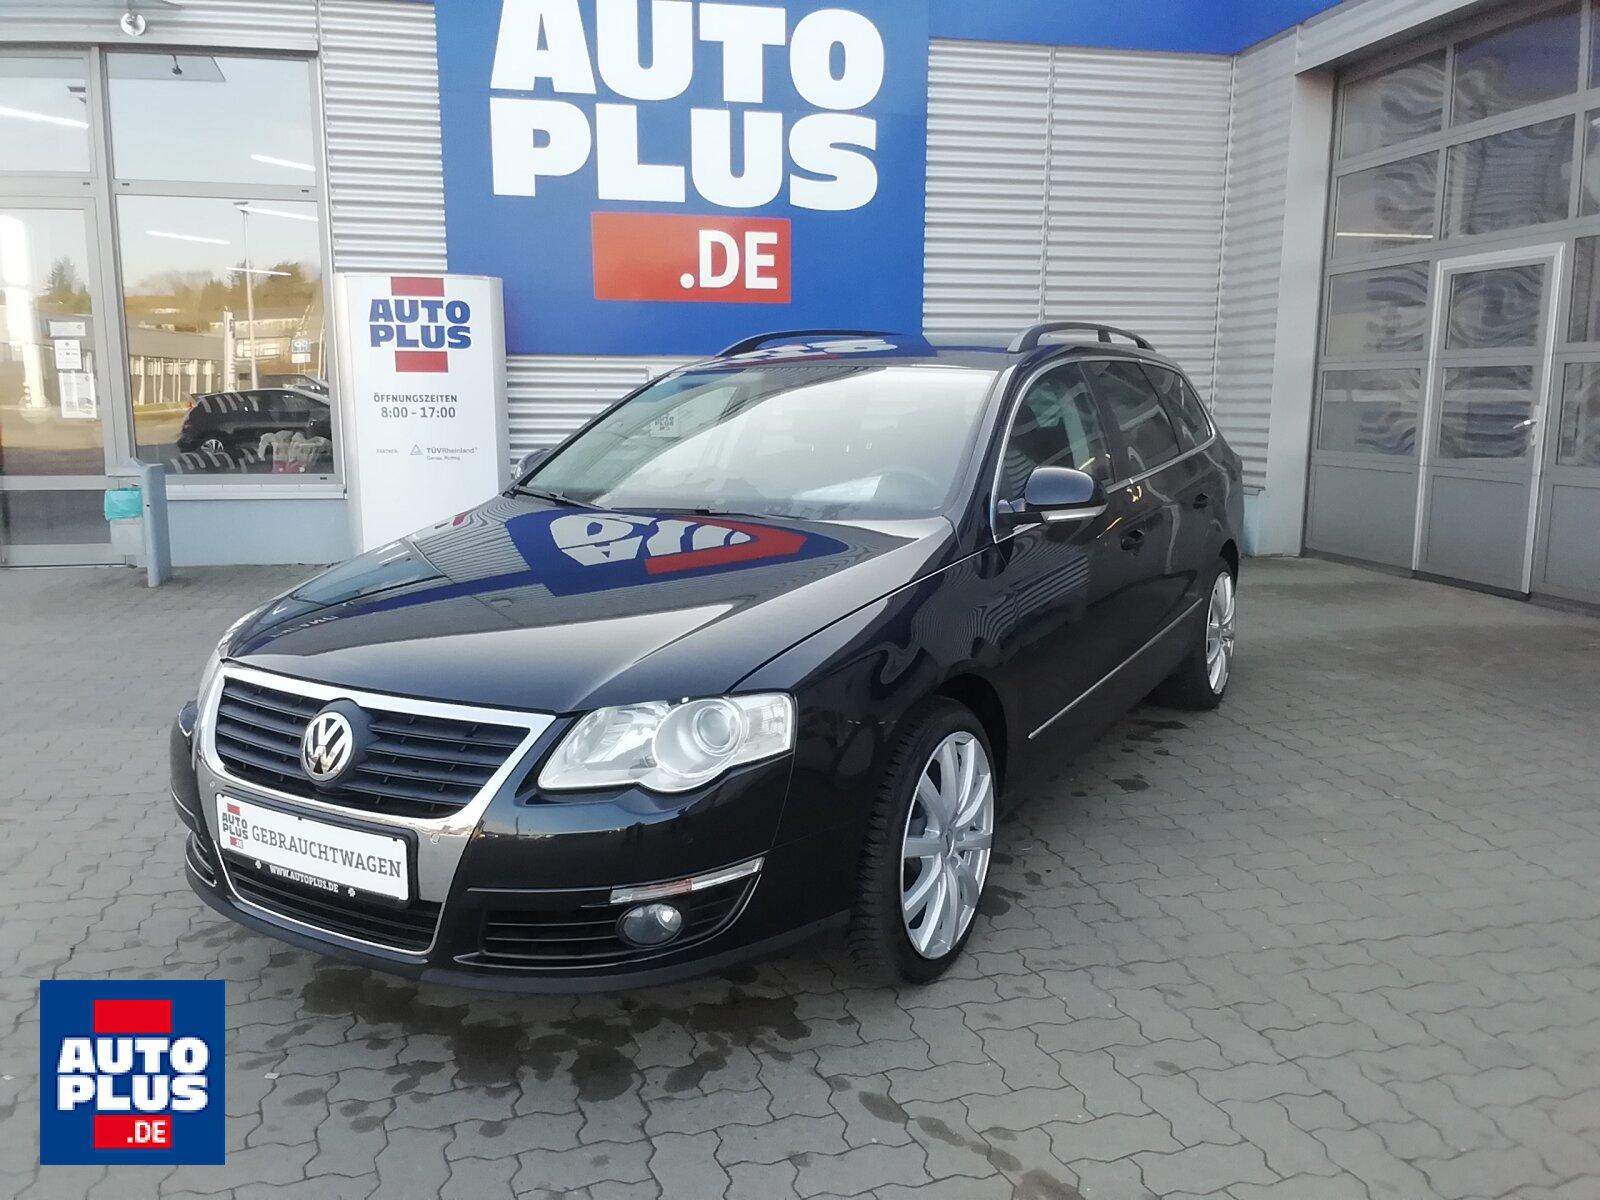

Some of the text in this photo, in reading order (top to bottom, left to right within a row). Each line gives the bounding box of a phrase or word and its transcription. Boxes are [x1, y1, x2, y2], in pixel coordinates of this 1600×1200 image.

[490, 0, 884, 110] AUTO
[490, 97, 878, 211] PLUS
[680, 230, 778, 290] .DE
[369, 299, 471, 324] AUTO
[370, 325, 472, 349] PLUS
[373, 392, 458, 403] ÖFFNUNGSZEITEN
[381, 407, 408, 418] 8:00
[420, 407, 456, 418] 17:00
[222, 812, 248, 830] AUTO
[223, 823, 249, 840] PLUS
[252, 825, 401, 878] GEBRAUCHTWAGEN
[269, 865, 339, 893] WWW.AUTOPLUS.DE
